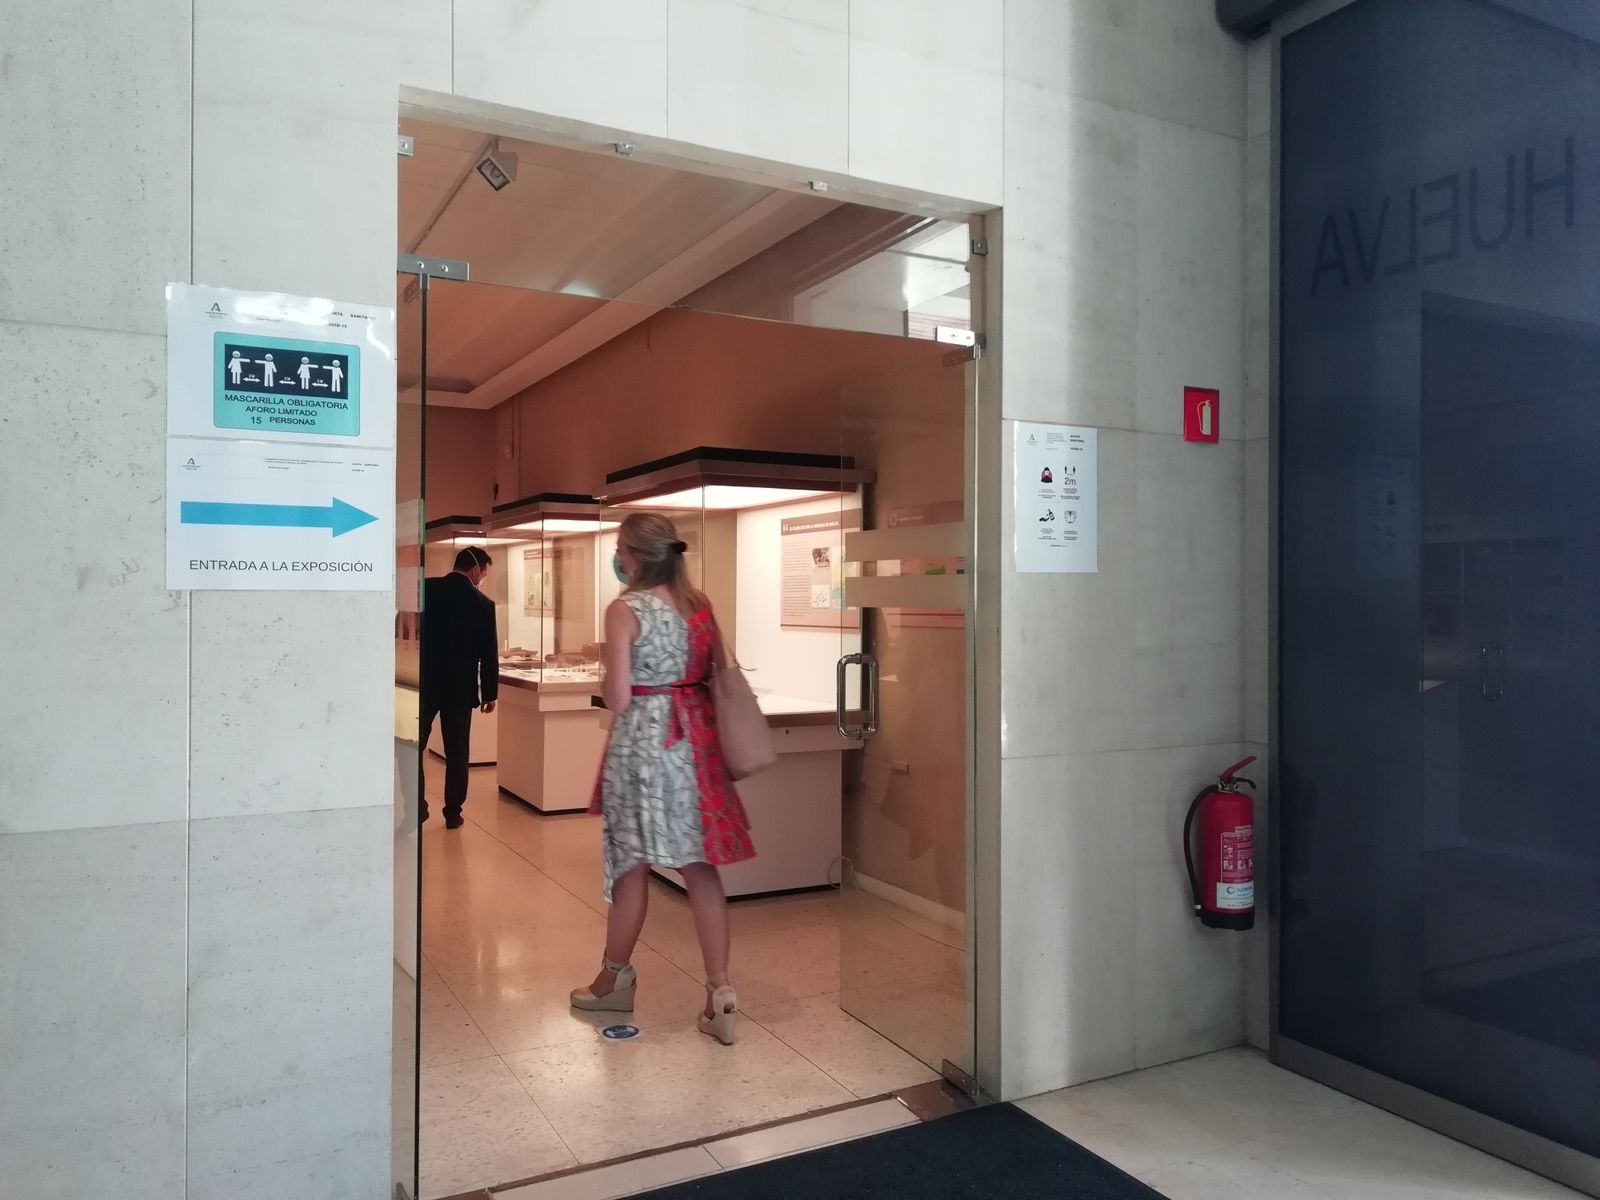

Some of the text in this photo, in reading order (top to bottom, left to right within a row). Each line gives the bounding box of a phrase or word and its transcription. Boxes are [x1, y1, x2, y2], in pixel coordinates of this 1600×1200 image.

[224, 394, 349, 410] MASCARILLA OBLIGATORIA
[245, 405, 318, 417] AFORO LIMITADO
[250, 416, 316, 425] 15 PERSONAS
[1064, 476, 1077, 486] 2m
[189, 559, 373, 572] ENTRADA A LA EXPOSICIÓN
